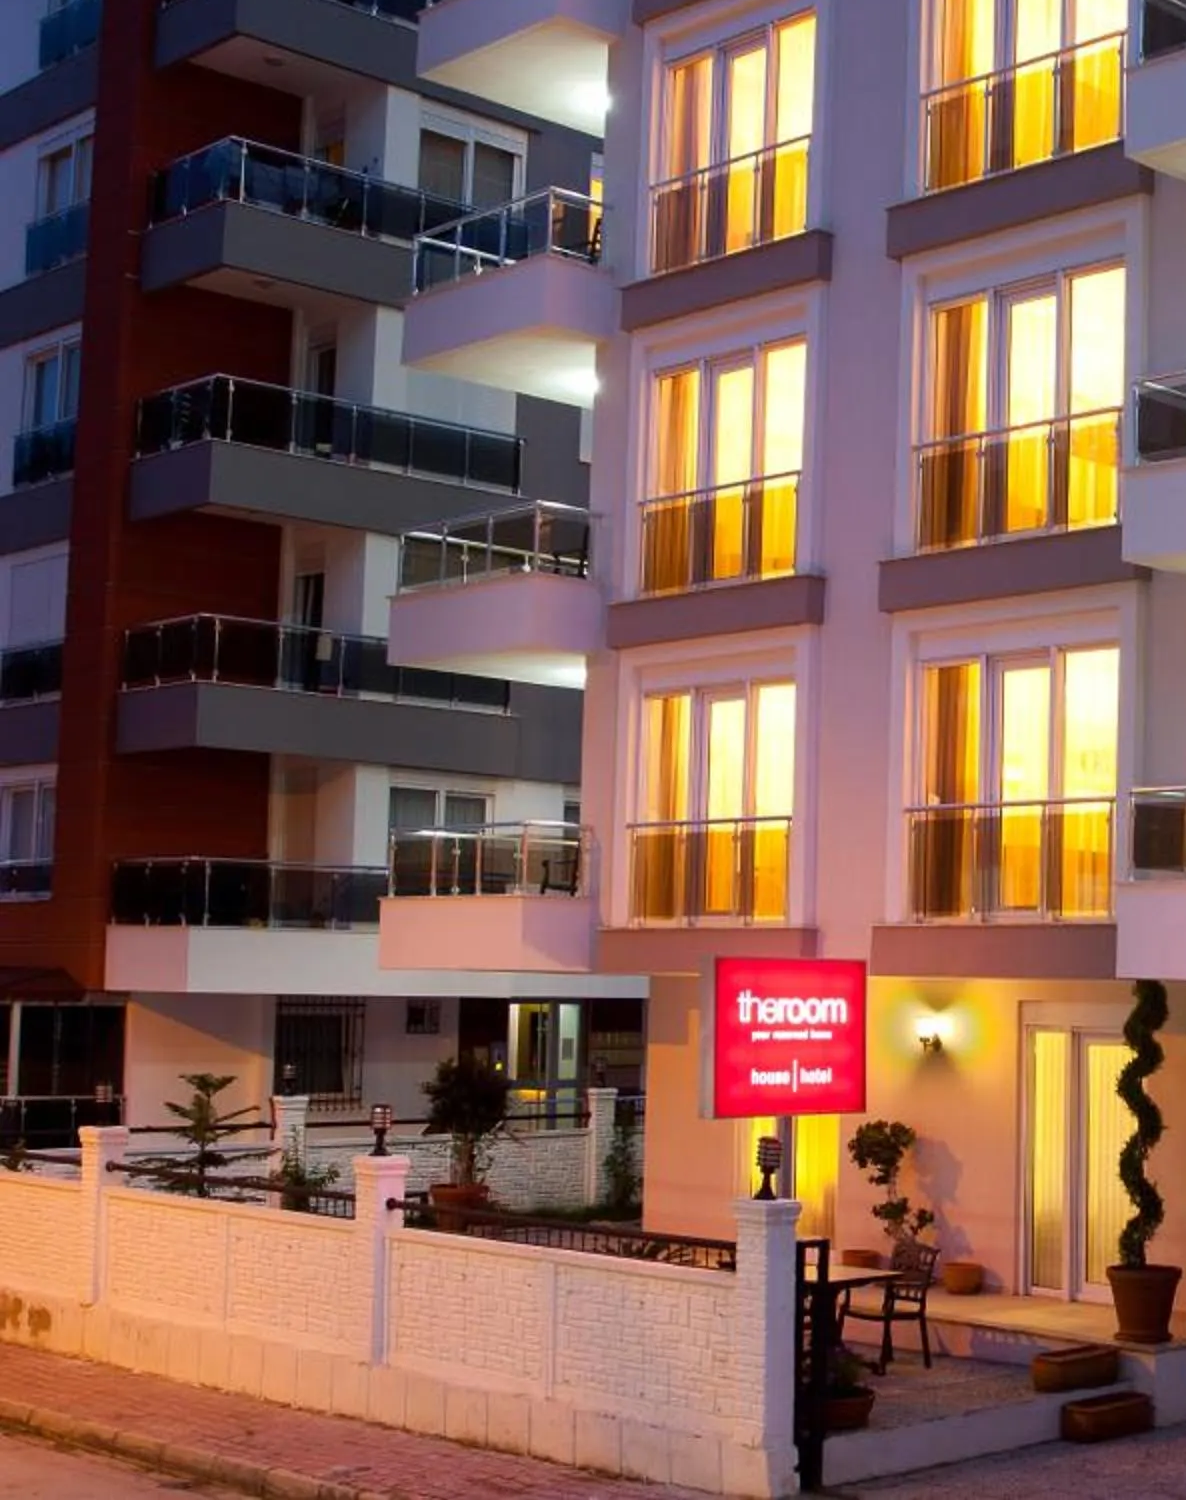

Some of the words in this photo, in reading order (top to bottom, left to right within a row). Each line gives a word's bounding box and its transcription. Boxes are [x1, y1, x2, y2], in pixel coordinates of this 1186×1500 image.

[737, 989, 847, 1024] theroom
[751, 1068, 790, 1085] house
[800, 1067, 832, 1084] hotel
